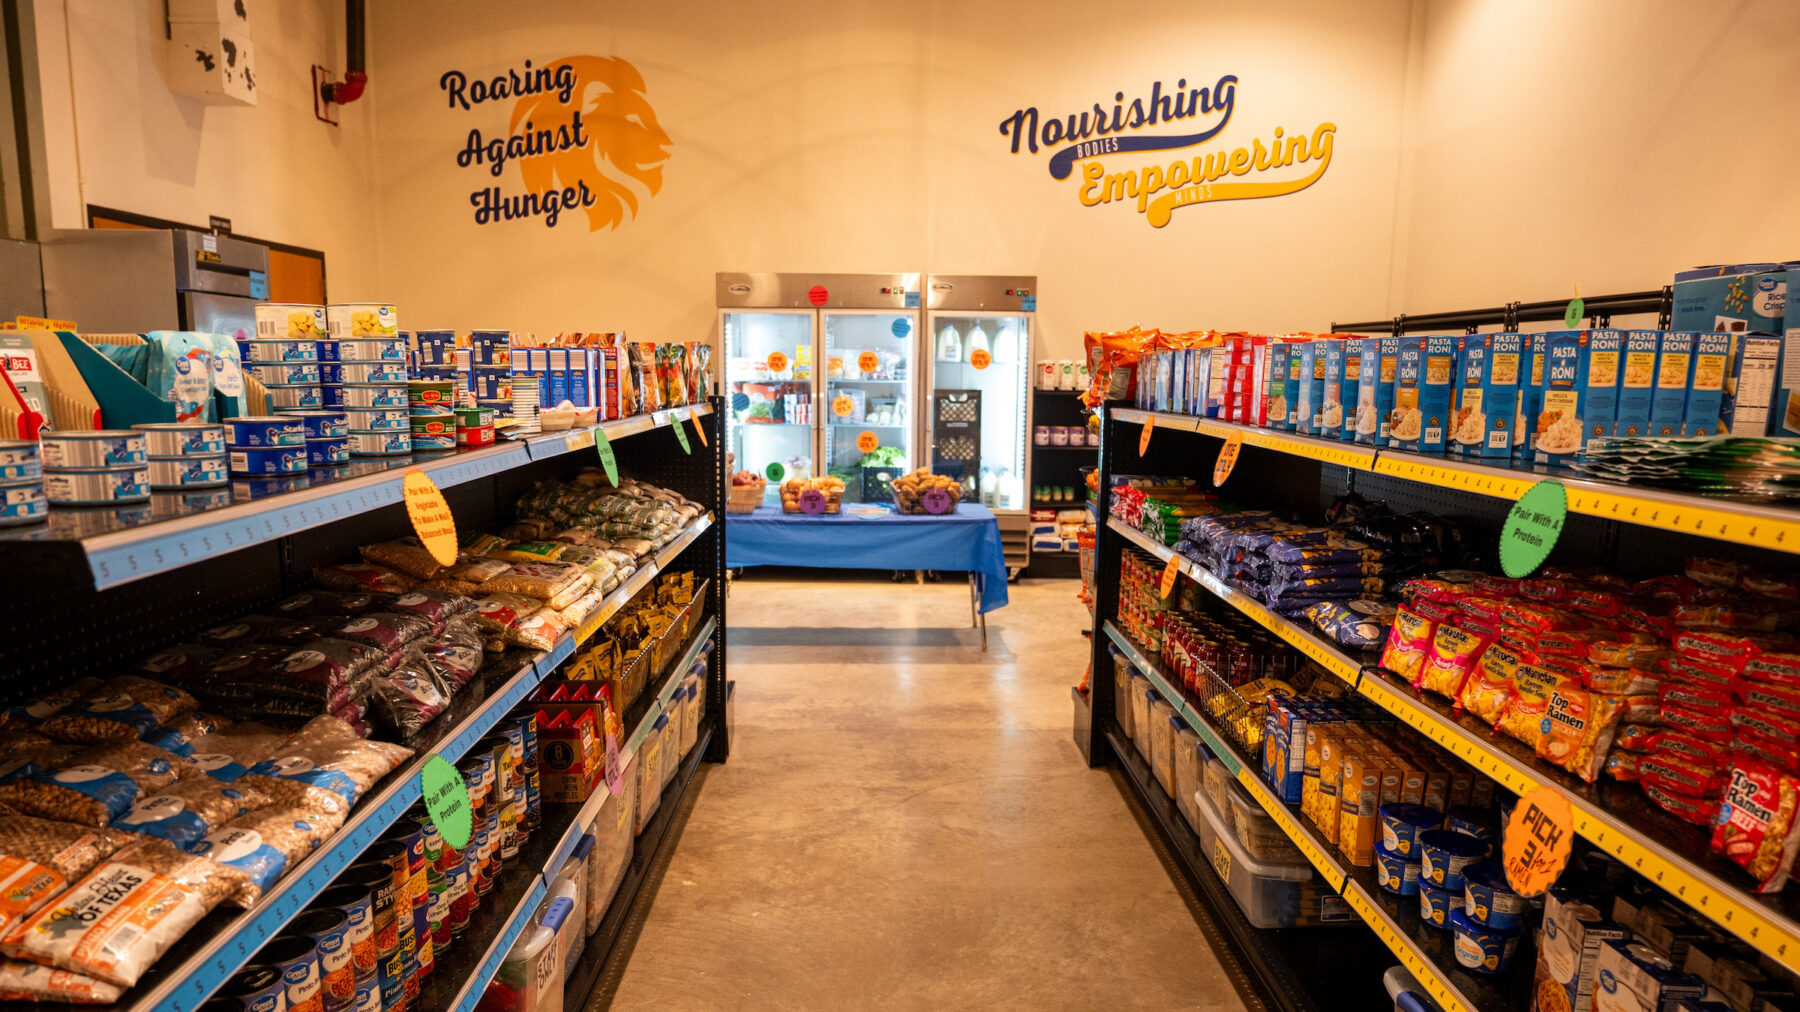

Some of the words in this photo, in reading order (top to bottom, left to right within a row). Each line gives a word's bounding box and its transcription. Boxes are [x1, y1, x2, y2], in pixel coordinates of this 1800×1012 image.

[440, 60, 577, 110] Roaring
[1000, 75, 1238, 160] Nourishing
[457, 111, 588, 176] Against
[1077, 137, 1119, 158] BODIES
[1079, 122, 1336, 213] Empowering
[470, 180, 595, 227] Hunger
[1175, 186, 1213, 203] MINDS
[1591, 340, 1619, 349] RONI
[1628, 341, 1656, 350] RONI
[1629, 332, 1656, 340] PASTA
[1662, 342, 1690, 351] RONI
[1663, 333, 1691, 341] PASTA
[1700, 334, 1728, 343] PASTA
[1402, 351, 1418, 360] PASTA
[1428, 345, 1451, 353] RONI
[1468, 348, 1483, 359] PASTA
[1552, 346, 1576, 358] PASTA
[1699, 343, 1727, 352] RONI
[1401, 367, 1417, 378] RONI
[1467, 366, 1482, 378] RONI
[1551, 366, 1575, 379] RONI
[1513, 506, 1532, 521] Pair
[1532, 512, 1551, 528] With
[1552, 519, 1560, 531] A
[1512, 527, 1543, 548] Protein
[1552, 692, 1568, 709] Top
[1546, 705, 1584, 730] Ramen
[428, 793, 441, 808] Pair
[440, 783, 455, 797] With
[454, 776, 461, 786] A
[1733, 770, 1757, 797] Top
[440, 799, 462, 822] Protein
[1727, 787, 1771, 822] Ramen
[1522, 803, 1563, 852] PICK
[1519, 839, 1538, 869] 3
[1508, 857, 1531, 887] RAMEN
[79, 905, 104, 921] OF
[97, 875, 143, 906] TEXAS
[1580, 821, 1586, 831] 4
[1598, 833, 1604, 842] 4
[1616, 845, 1623, 855] 4
[1635, 858, 1643, 868] 4
[1656, 871, 1663, 882] 4
[1678, 886, 1686, 896] 4
[1700, 895, 1708, 906] 4
[1724, 911, 1733, 922] 4
[1750, 927, 1759, 938] 4
[1777, 944, 1786, 956] 4
[537, 939, 558, 971] STAFF
